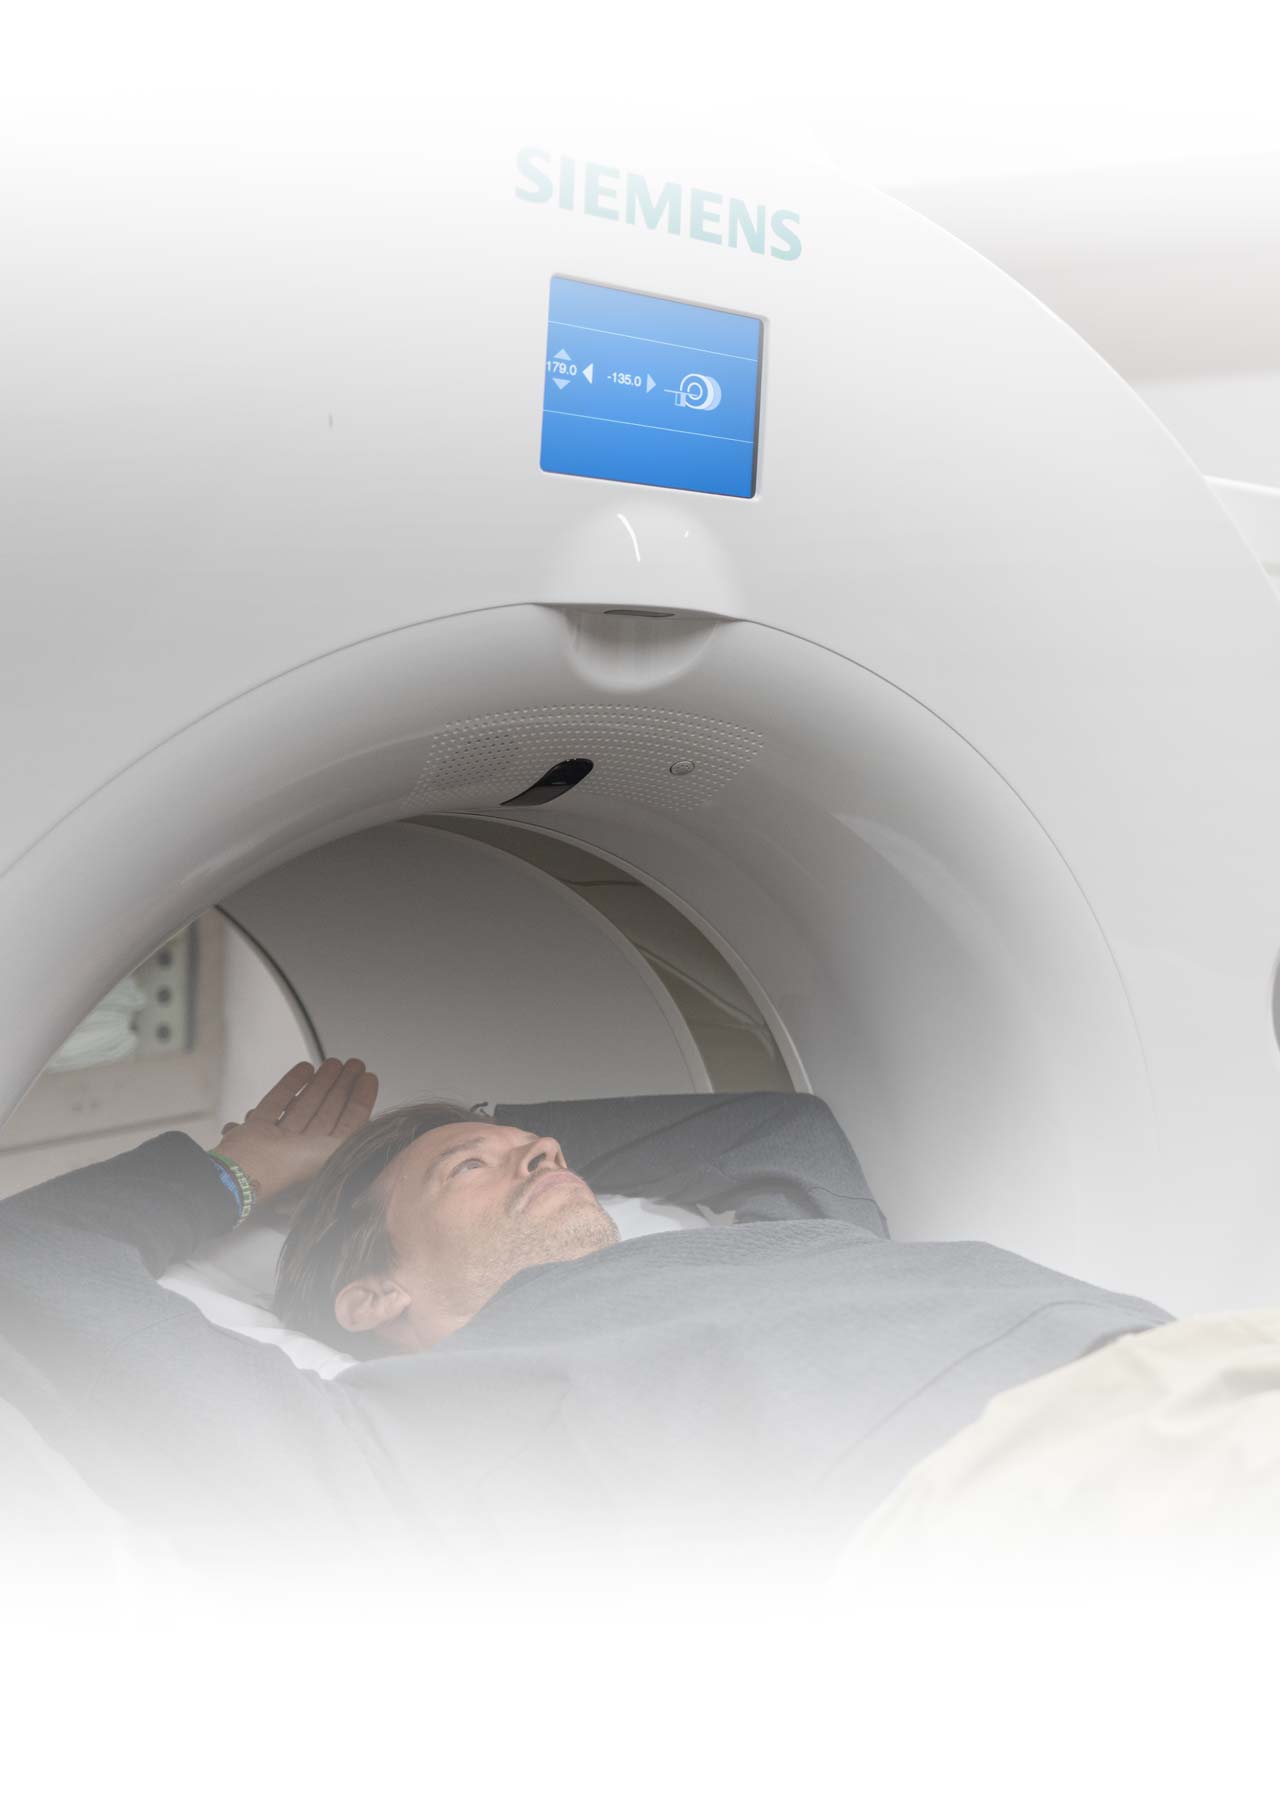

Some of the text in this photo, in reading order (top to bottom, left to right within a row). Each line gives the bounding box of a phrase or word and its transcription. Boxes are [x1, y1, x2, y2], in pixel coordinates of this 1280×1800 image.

[515, 146, 802, 261] SIEMENS
[546, 361, 577, 376] 179.0
[607, 372, 642, 388] -135.0
